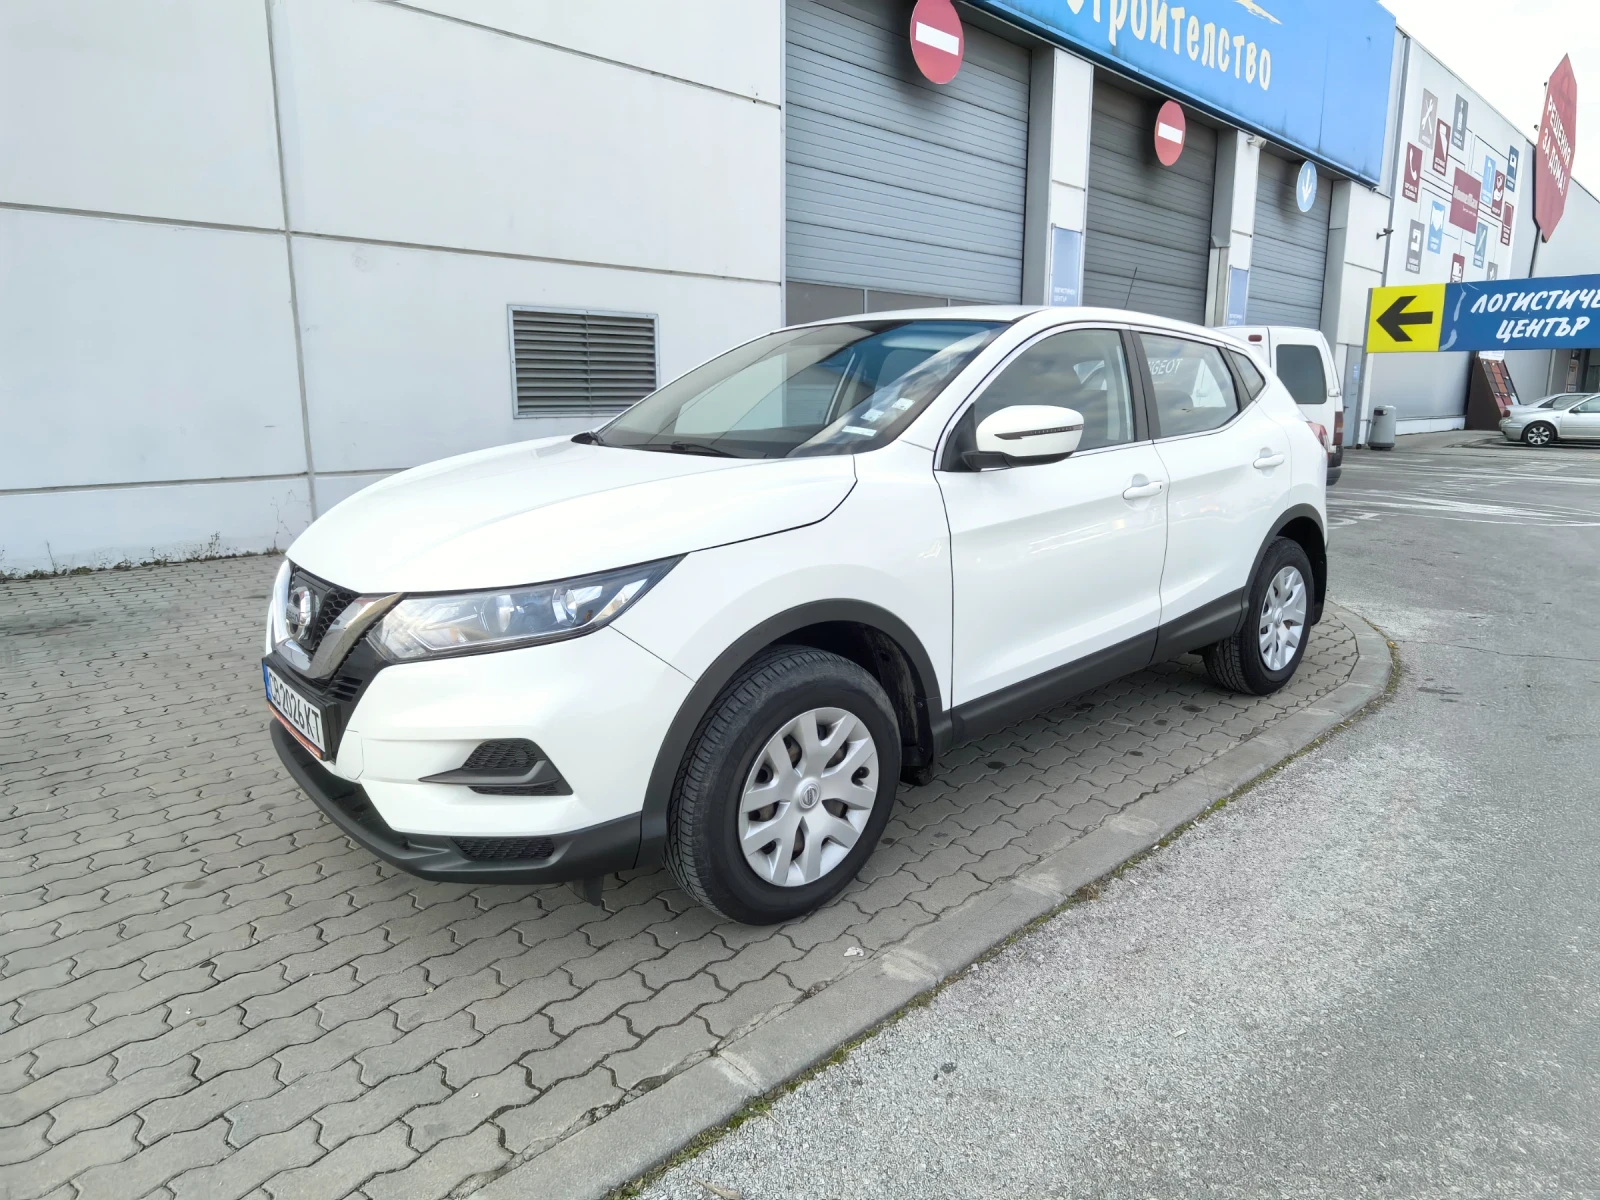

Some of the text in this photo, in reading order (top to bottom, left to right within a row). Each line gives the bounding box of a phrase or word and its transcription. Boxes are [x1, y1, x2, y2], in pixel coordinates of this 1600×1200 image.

[1067, 0, 1271, 91] роителство
[1542, 127, 1566, 197] ЗА ДОМА!
[1546, 94, 1571, 169] РЕШЕНИЯ
[1495, 316, 1591, 344] ЦЕНТЪР
